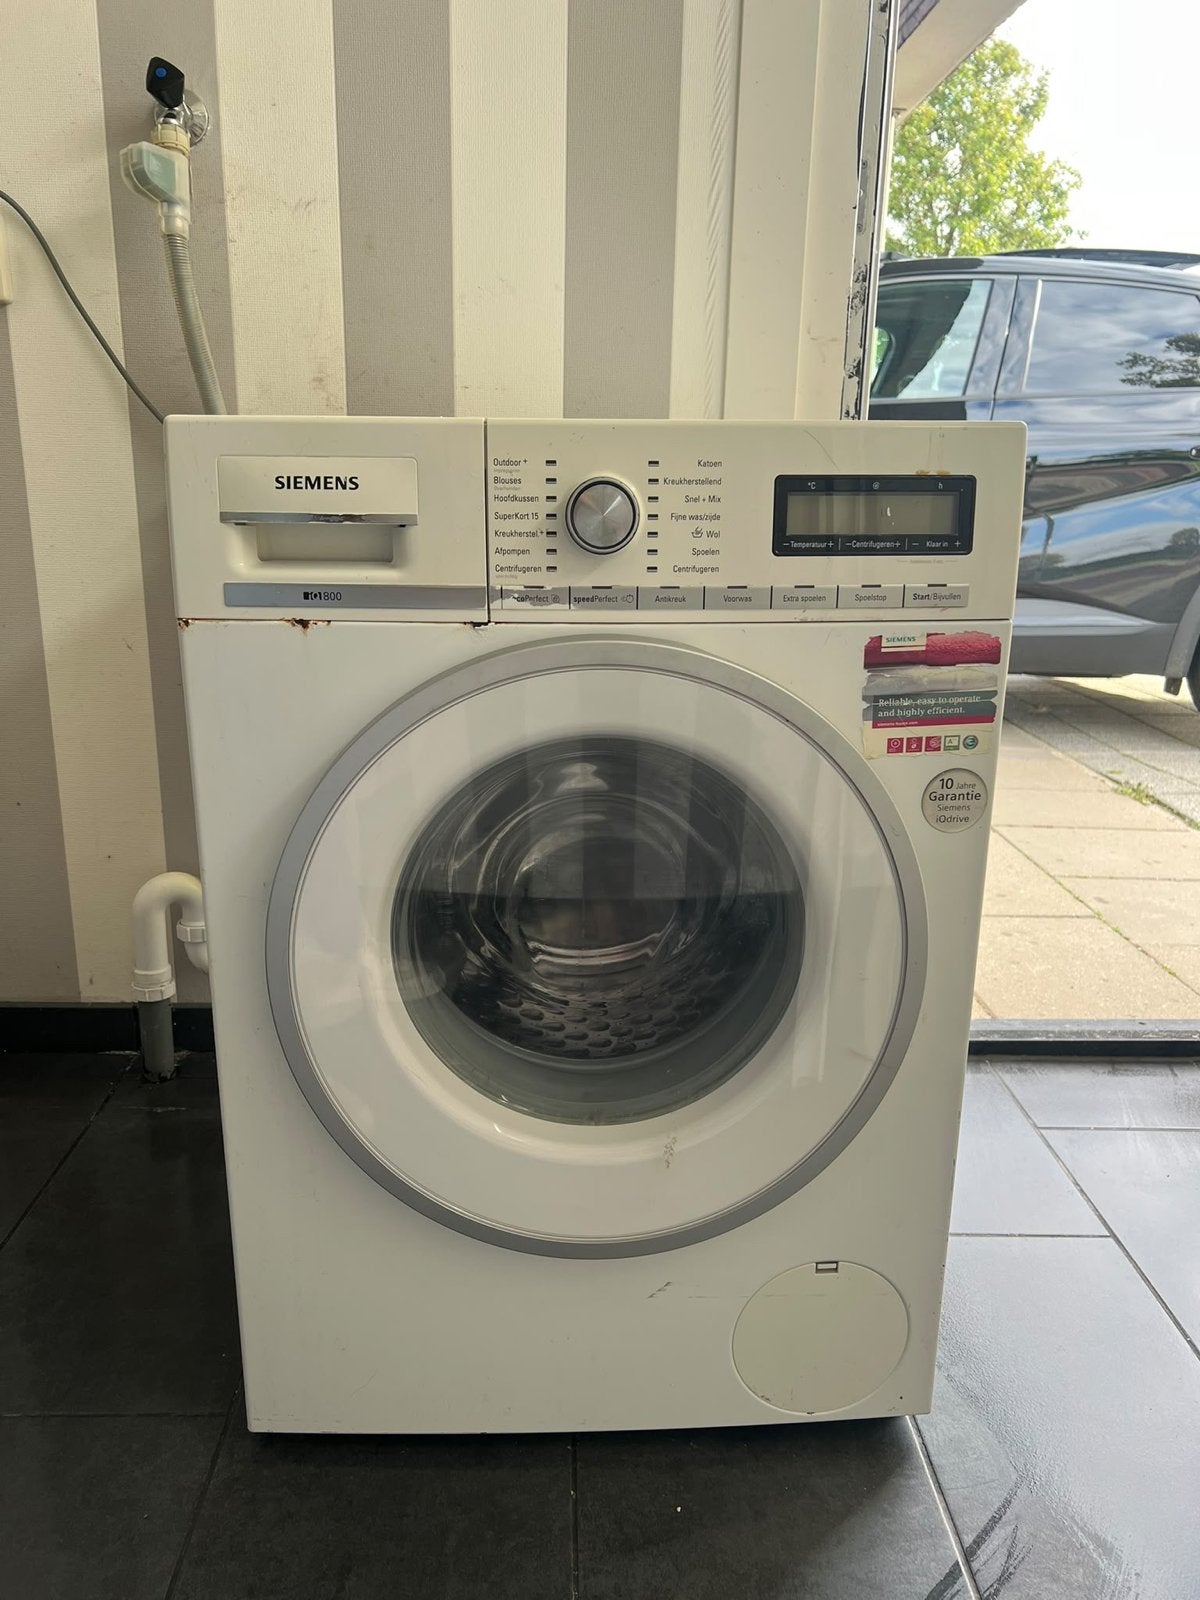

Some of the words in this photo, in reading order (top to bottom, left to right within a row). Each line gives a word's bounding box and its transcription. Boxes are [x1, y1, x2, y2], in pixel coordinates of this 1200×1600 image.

[493, 458, 521, 466] Outdoor
[697, 459, 722, 467] Katoen
[275, 476, 359, 490] SIEMENS
[493, 476, 522, 484] Blouses
[663, 477, 722, 485] Kreukherstellend
[493, 494, 540, 502] Hoofdkussen
[684, 495, 700, 503] Snel
[708, 495, 722, 503] Mix
[494, 512, 530, 520] SuperKort
[670, 512, 687, 521] Fijne
[688, 512, 721, 522] was/zijde
[706, 530, 721, 538] Wol
[790, 540, 827, 549] Temperatuur
[851, 540, 894, 549] Centrifugeren
[926, 540, 941, 548] Klaar
[942, 540, 949, 548] in
[494, 547, 531, 556] Afpompen
[691, 547, 720, 556] Spoelen
[495, 564, 542, 574] Centrifugeren
[672, 565, 720, 574] Centrifugeren
[573, 594, 618, 603] speedPerfect
[654, 594, 687, 603] Antikreuk
[723, 594, 752, 603] Voorwas
[783, 594, 800, 602] Extra
[801, 594, 827, 604] spoelen
[854, 593, 887, 602] Spoelstop
[912, 592, 961, 601] Start/Bijvullen
[917, 698, 936, 706] easy
[948, 695, 981, 706] operate
[878, 708, 895, 718] and
[897, 707, 925, 718] highly
[927, 706, 966, 715] efficient.
[939, 778, 954, 790] 10
[956, 782, 976, 790] Jahre
[929, 790, 982, 802] Garantie
